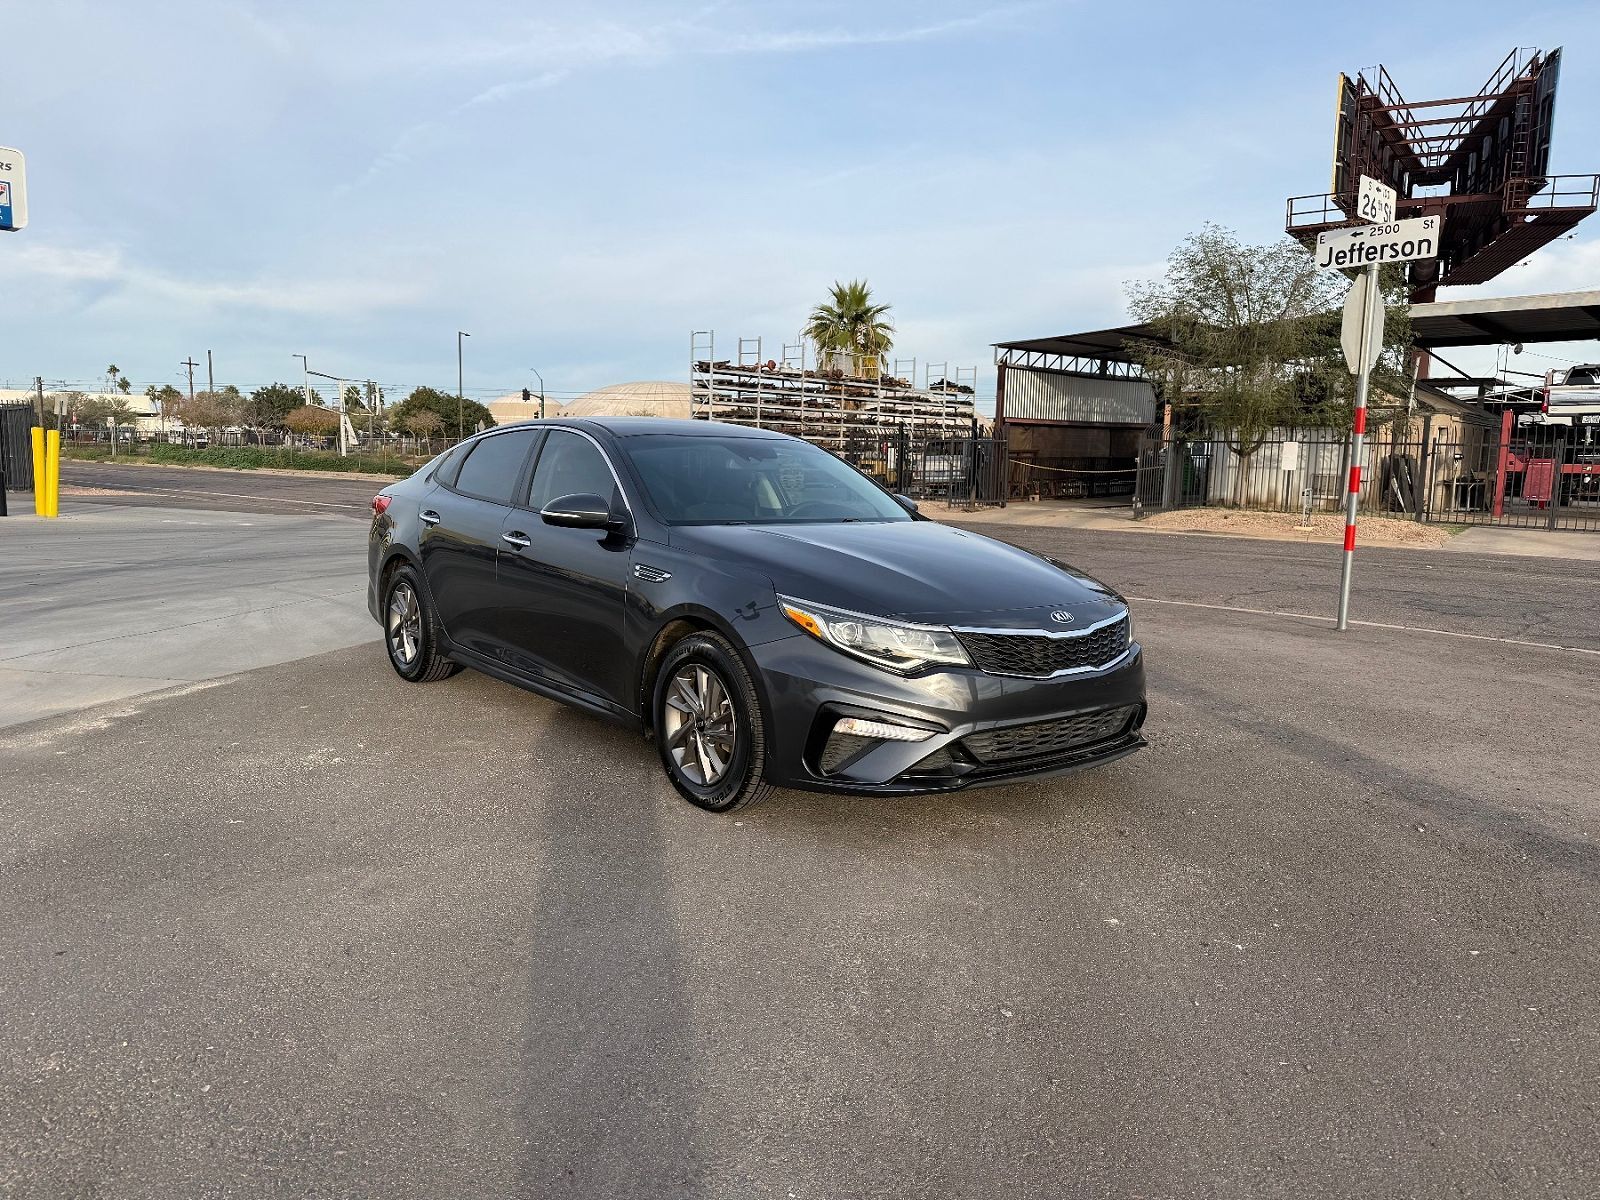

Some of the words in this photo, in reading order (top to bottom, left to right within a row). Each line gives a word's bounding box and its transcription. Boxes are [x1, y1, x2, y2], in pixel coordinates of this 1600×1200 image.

[1368, 181, 1373, 191] S
[1383, 202, 1392, 223] St
[1319, 235, 1326, 245] E
[1369, 223, 1400, 237] 2500
[1422, 219, 1434, 230] St
[1319, 238, 1432, 268] Jefferson
[1052, 611, 1074, 622] KIA
